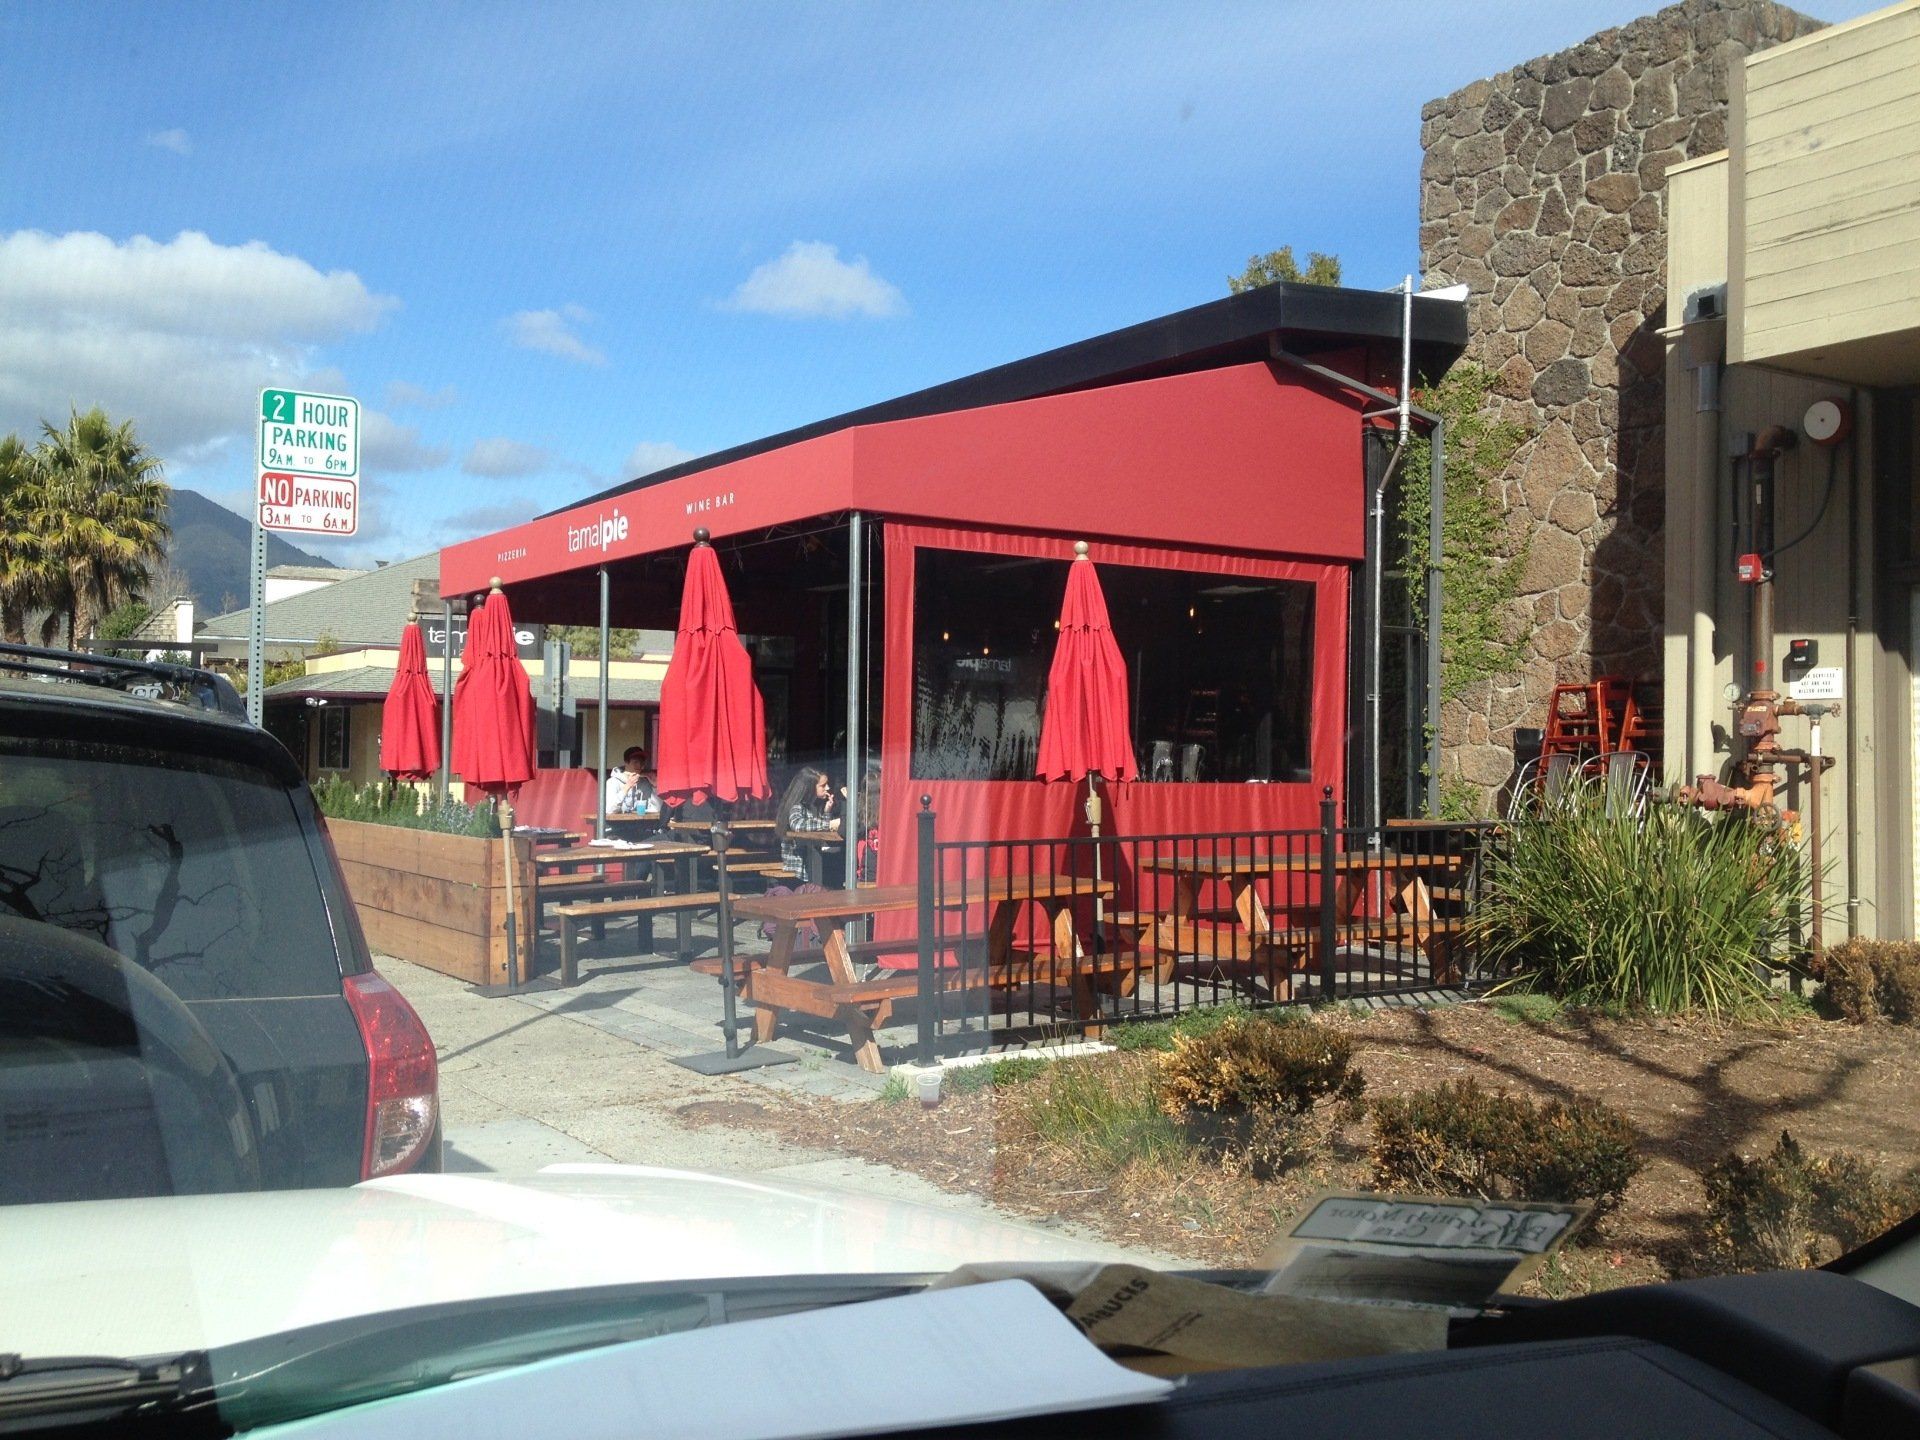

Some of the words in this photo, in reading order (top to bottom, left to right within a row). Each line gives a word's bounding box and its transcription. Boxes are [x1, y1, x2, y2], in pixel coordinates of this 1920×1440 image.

[272, 394, 286, 421] 2
[302, 402, 348, 427] HOUR
[273, 426, 347, 451] PARKING
[304, 456, 314, 465] TO
[325, 455, 347, 471] 6PM
[264, 477, 290, 505] NO
[295, 487, 352, 510] PARKING
[686, 498, 711, 515] WINE
[715, 492, 735, 507] BAR
[301, 515, 312, 523] TO
[567, 508, 629, 553] tamalpie
[497, 548, 527, 563] PIZZERIA
[428, 626, 535, 647] tamie
